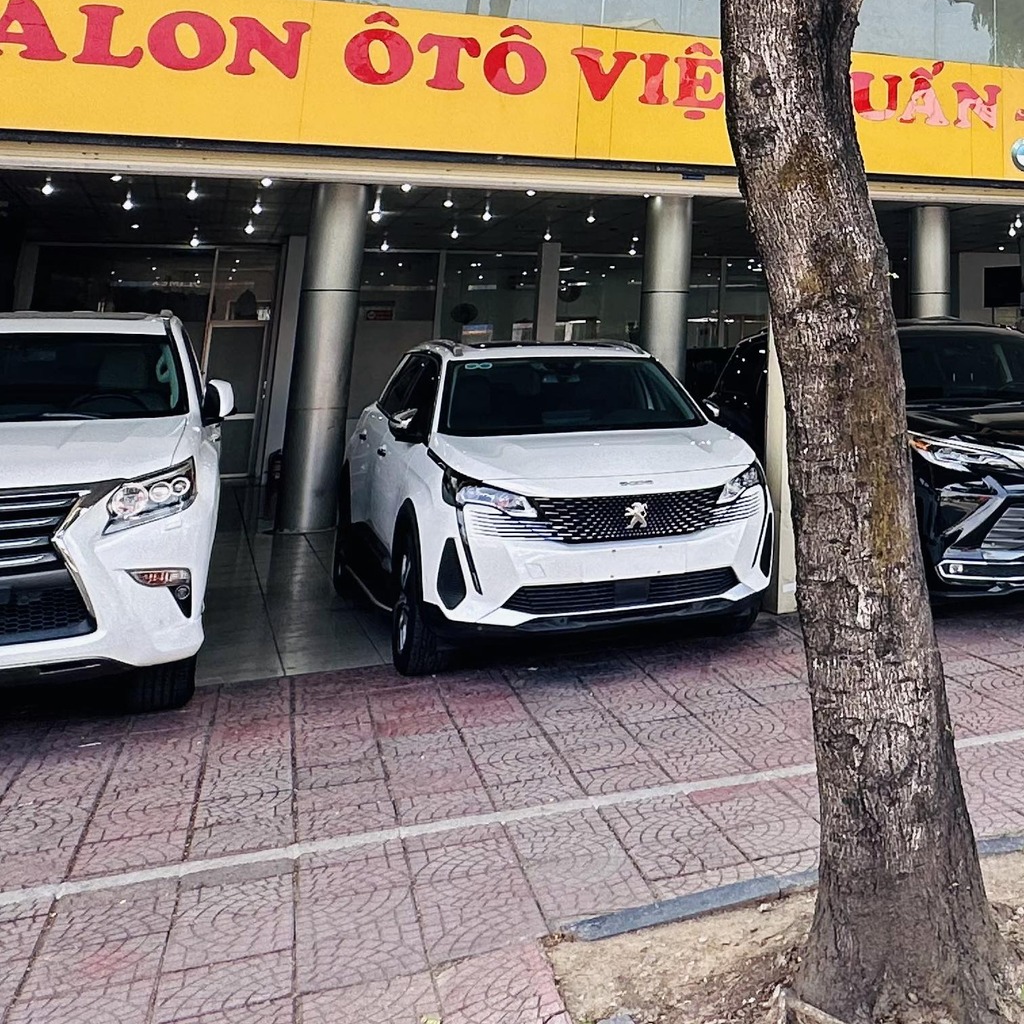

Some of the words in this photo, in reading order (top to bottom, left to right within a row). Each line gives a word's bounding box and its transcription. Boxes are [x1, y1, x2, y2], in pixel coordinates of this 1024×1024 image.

[344, 10, 548, 96] ÔTÔ
[571, 42, 725, 120] VIỆ
[853, 60, 1002, 129] UẤN
